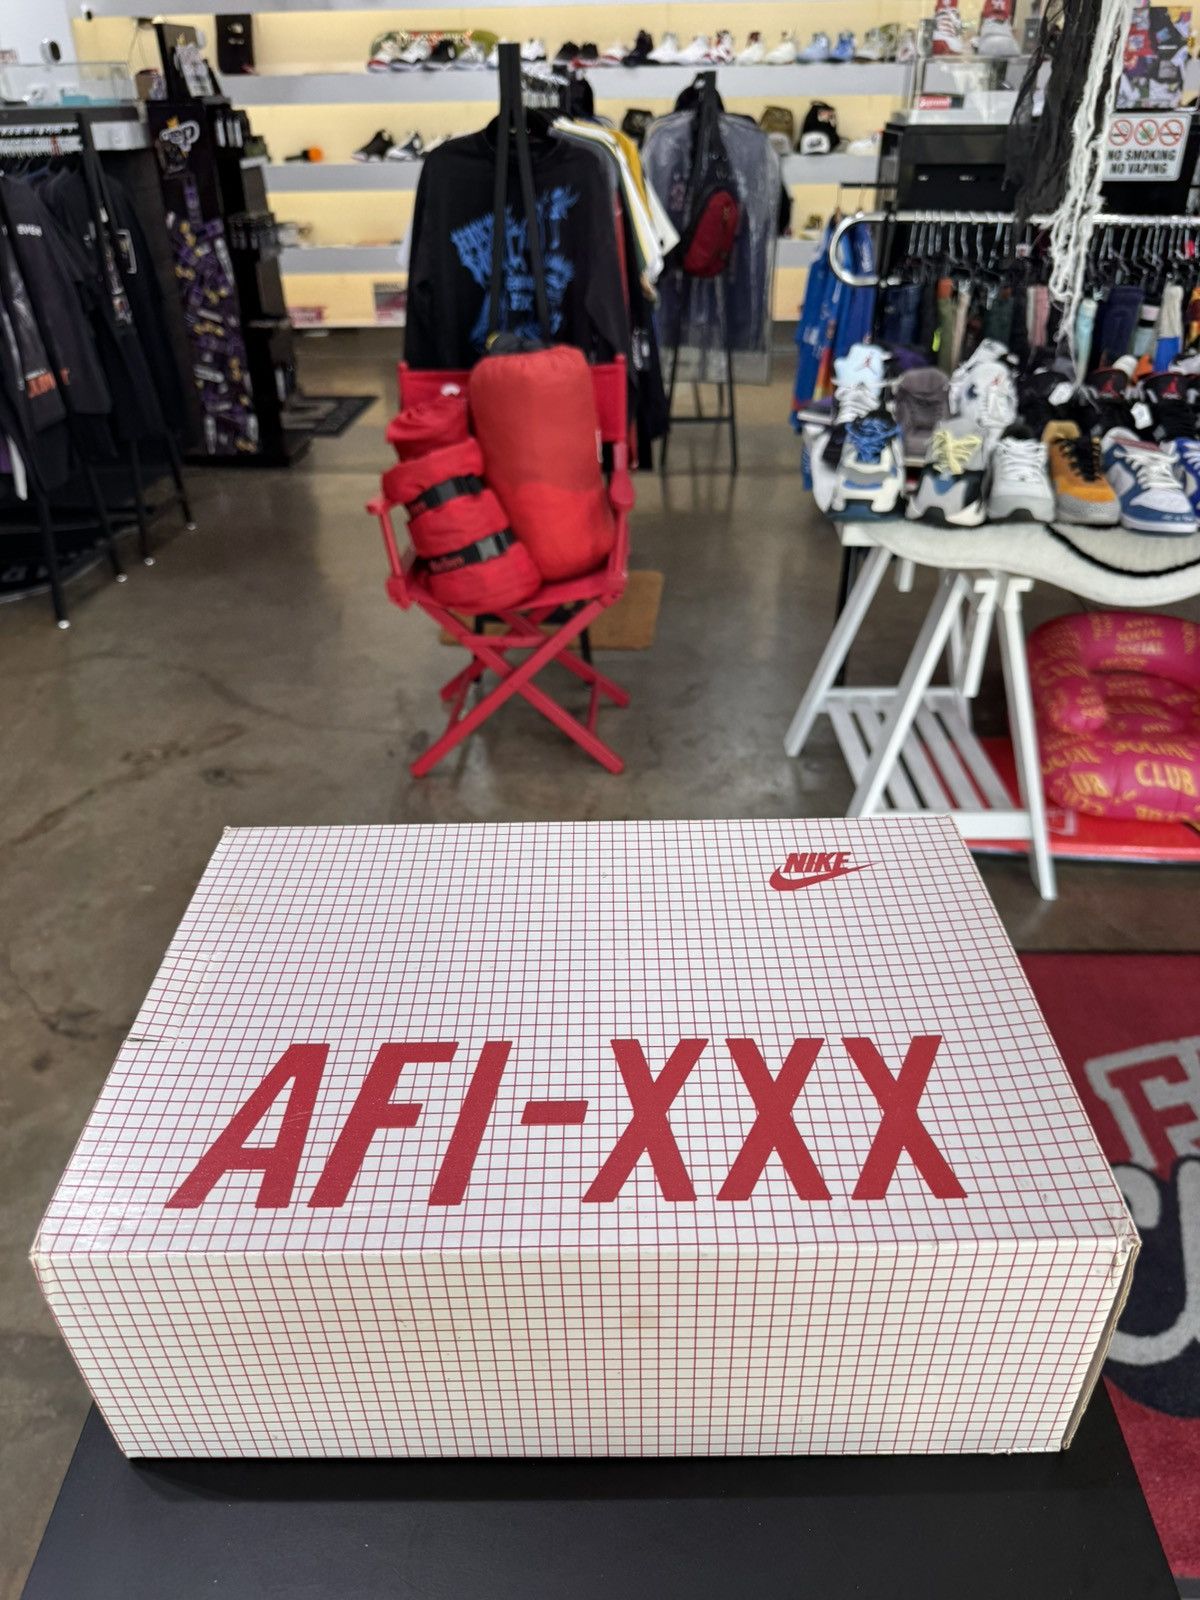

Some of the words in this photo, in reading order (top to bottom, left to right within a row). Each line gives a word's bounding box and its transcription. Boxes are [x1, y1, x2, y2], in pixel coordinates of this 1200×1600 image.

[1107, 150, 1122, 160] NO
[1125, 149, 1176, 161] SMOKING
[1110, 163, 1125, 174] NO
[1128, 162, 1168, 174] VAPING
[1116, 628, 1164, 642] SOCIAL
[1134, 760, 1198, 799] CLUB
[783, 851, 851, 874] NIKE
[164, 1035, 968, 1209] AFI-XXX
